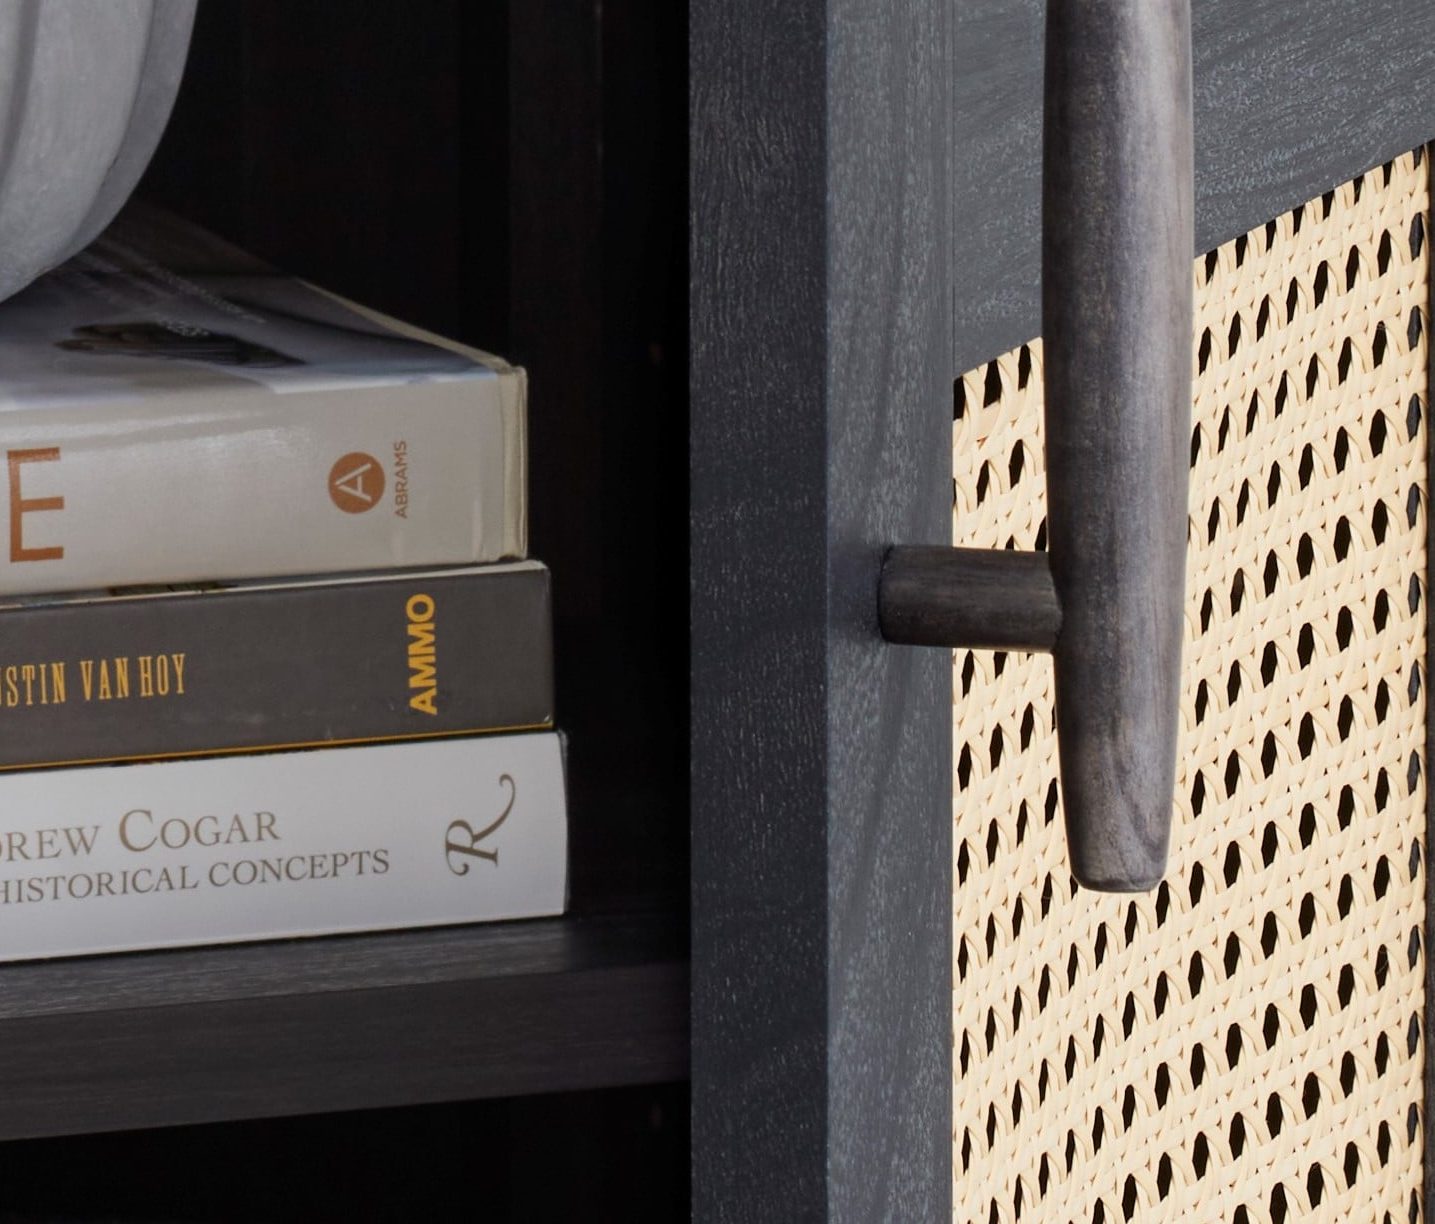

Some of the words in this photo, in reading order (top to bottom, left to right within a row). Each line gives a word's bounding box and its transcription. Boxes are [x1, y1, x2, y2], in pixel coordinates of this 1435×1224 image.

[334, 462, 372, 503] A
[392, 440, 408, 519] ABRAMS
[79, 657, 129, 702] VAN
[140, 653, 186, 697] HOY
[406, 593, 439, 716] AMMO
[208, 848, 390, 889] CONCEPTS
